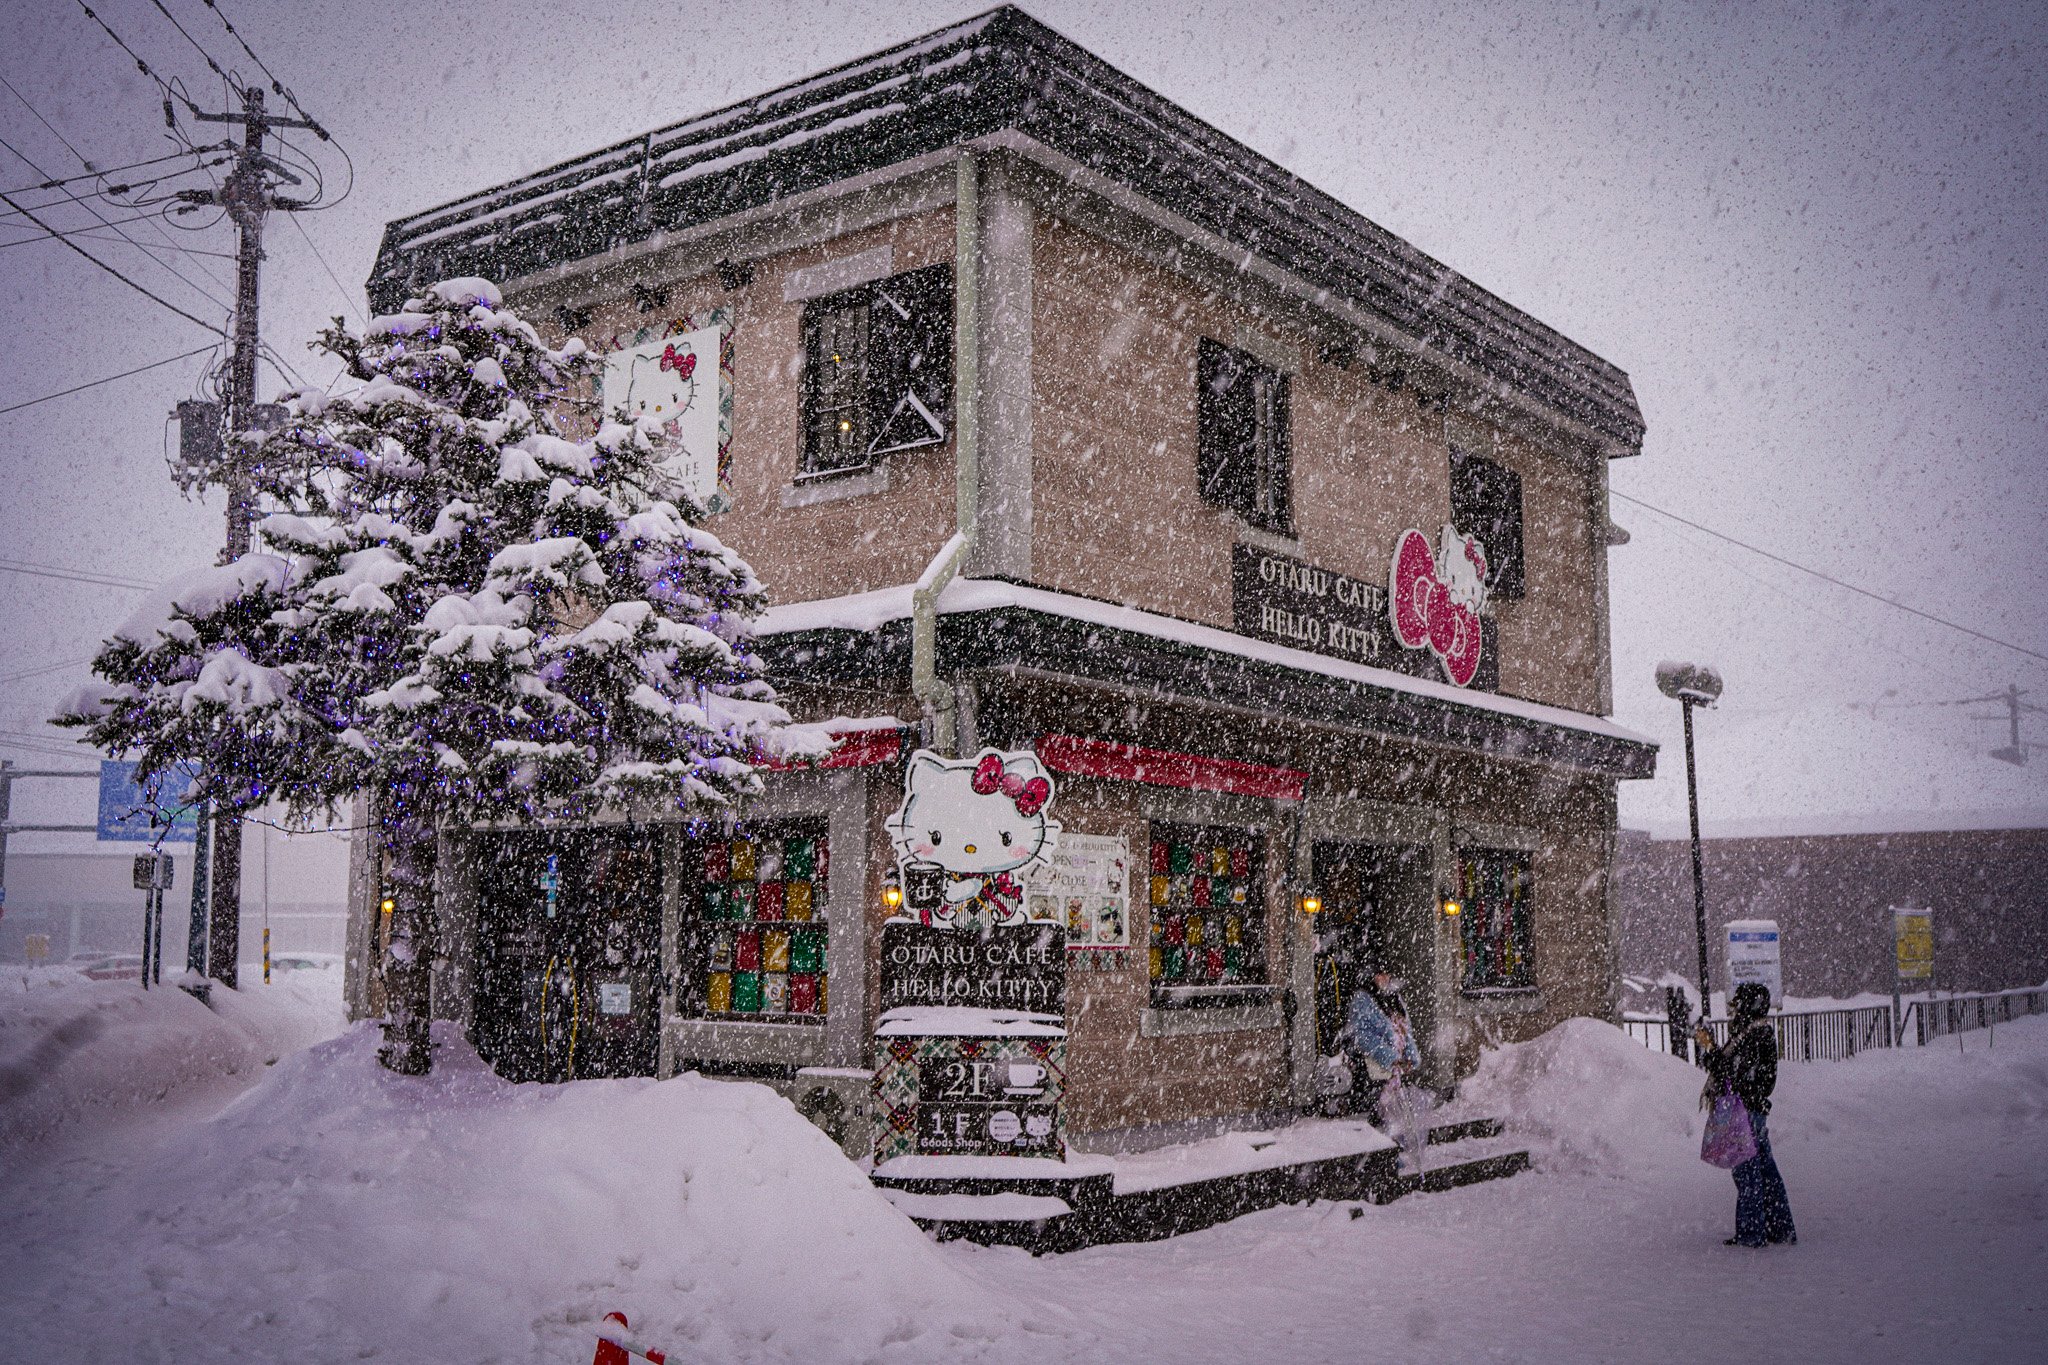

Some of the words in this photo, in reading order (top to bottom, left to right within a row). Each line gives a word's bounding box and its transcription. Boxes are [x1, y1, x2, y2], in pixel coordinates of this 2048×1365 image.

[1260, 556, 1327, 597] OTARU
[1336, 577, 1382, 612] CAFE
[1261, 604, 1320, 643] HELLO
[1328, 621, 1381, 657] KITTY
[891, 946, 974, 965] OTARU
[986, 946, 1052, 965] CAFE
[893, 978, 970, 998] HELLO
[979, 979, 1052, 998] KITTY
[943, 1062, 996, 1097] 2F
[920, 1136, 954, 1148] Goods
[955, 1136, 982, 1150] Shop
